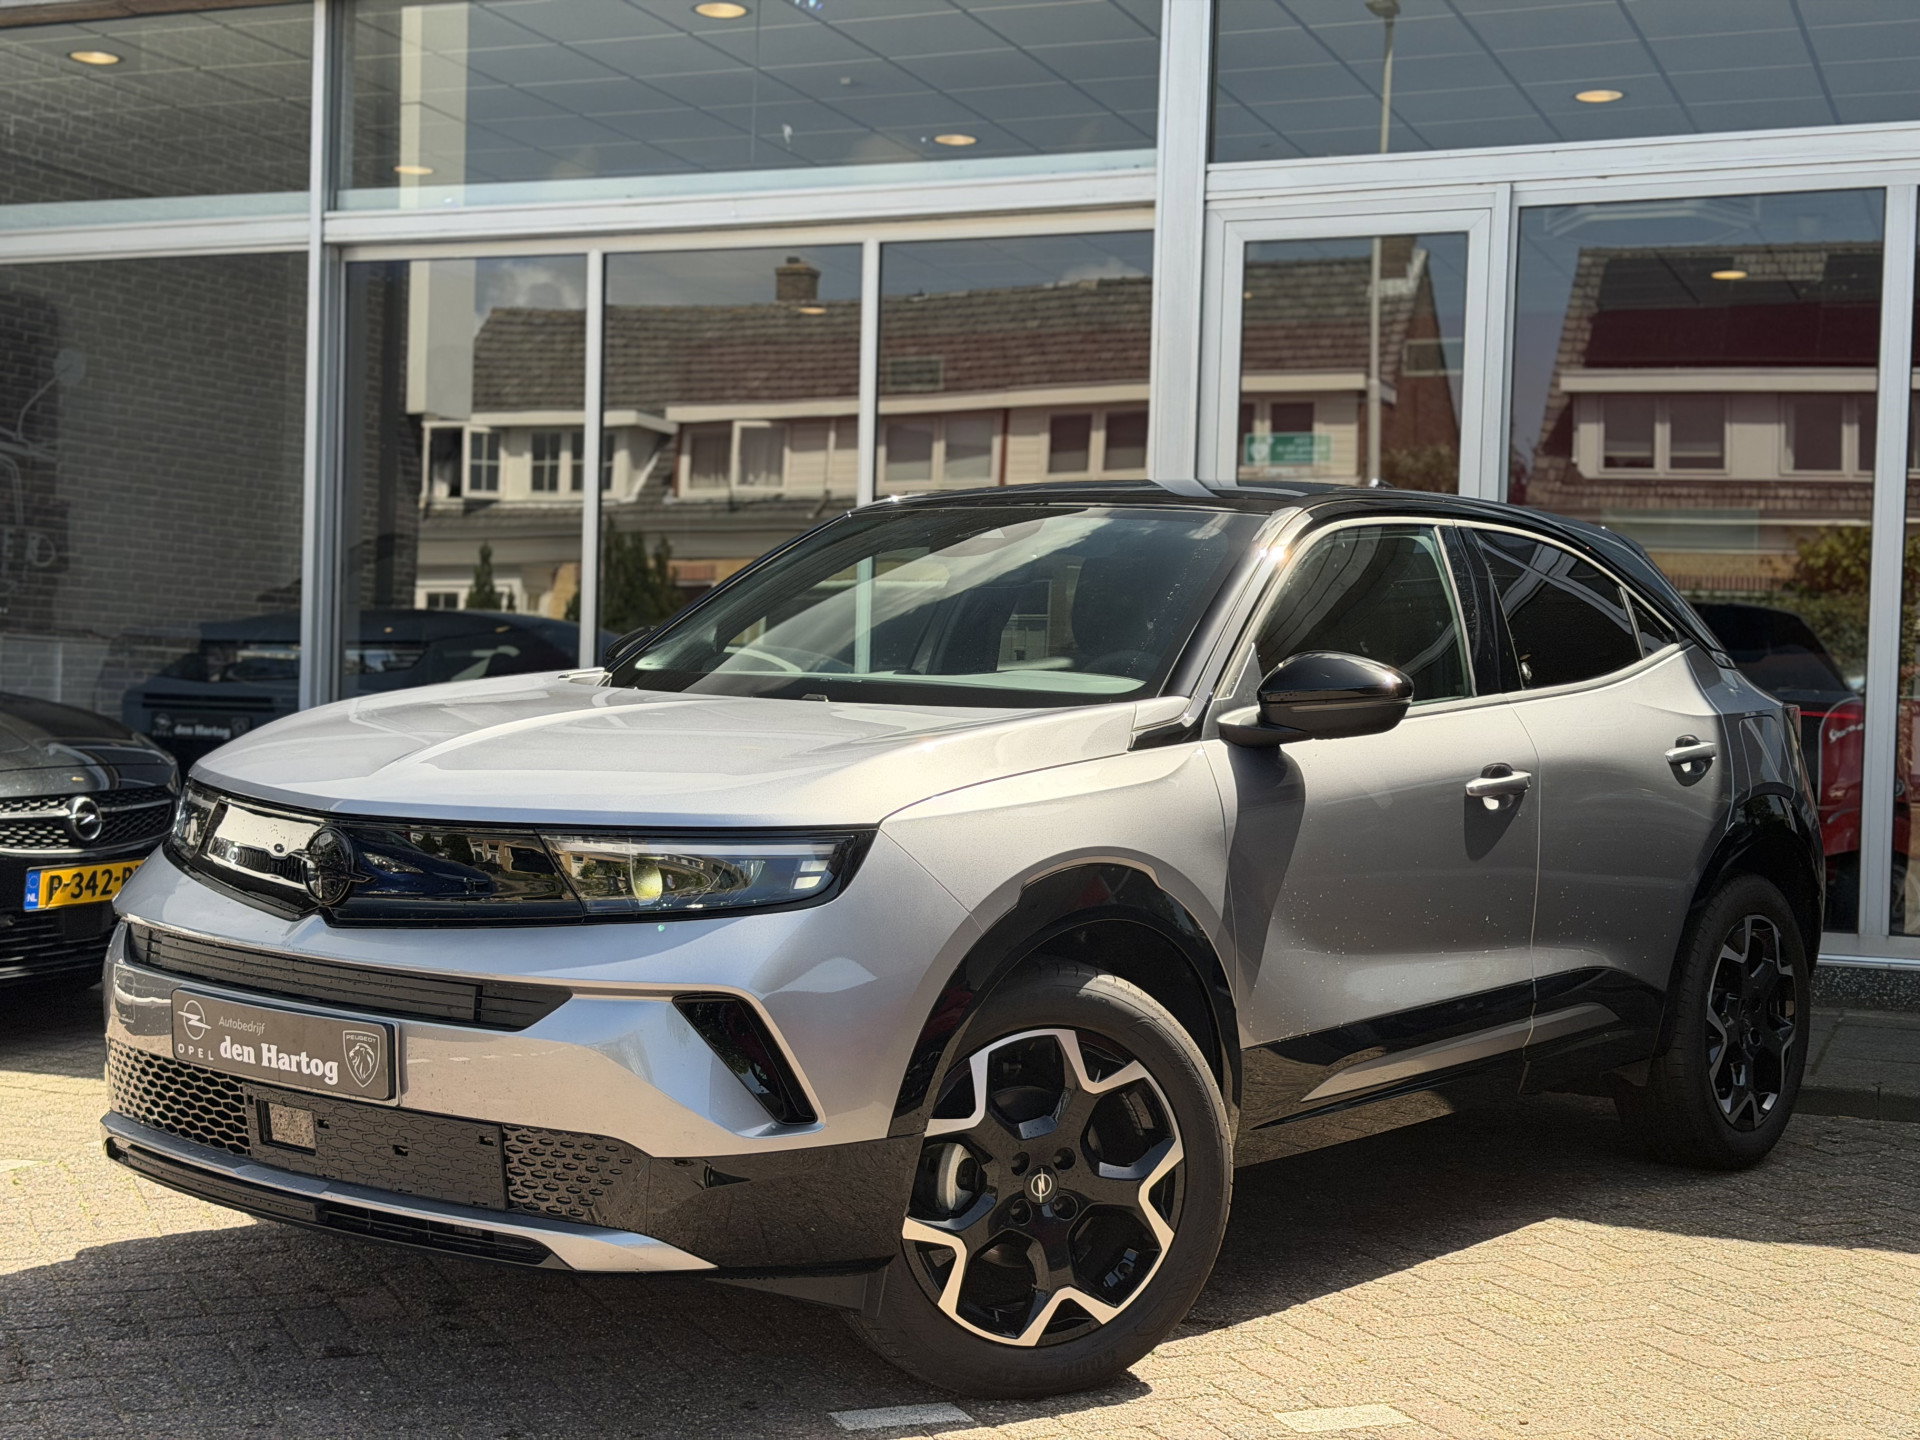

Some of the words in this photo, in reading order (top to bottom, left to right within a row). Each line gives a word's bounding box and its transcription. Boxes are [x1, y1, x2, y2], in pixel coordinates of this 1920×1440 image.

[26, 893, 38, 902] NL
[218, 1016, 266, 1036] Autobedrijf
[346, 1034, 376, 1043] PEUGEOT
[177, 1043, 214, 1061] OPEL
[219, 1035, 256, 1065] den
[260, 1042, 339, 1086] Hartog
